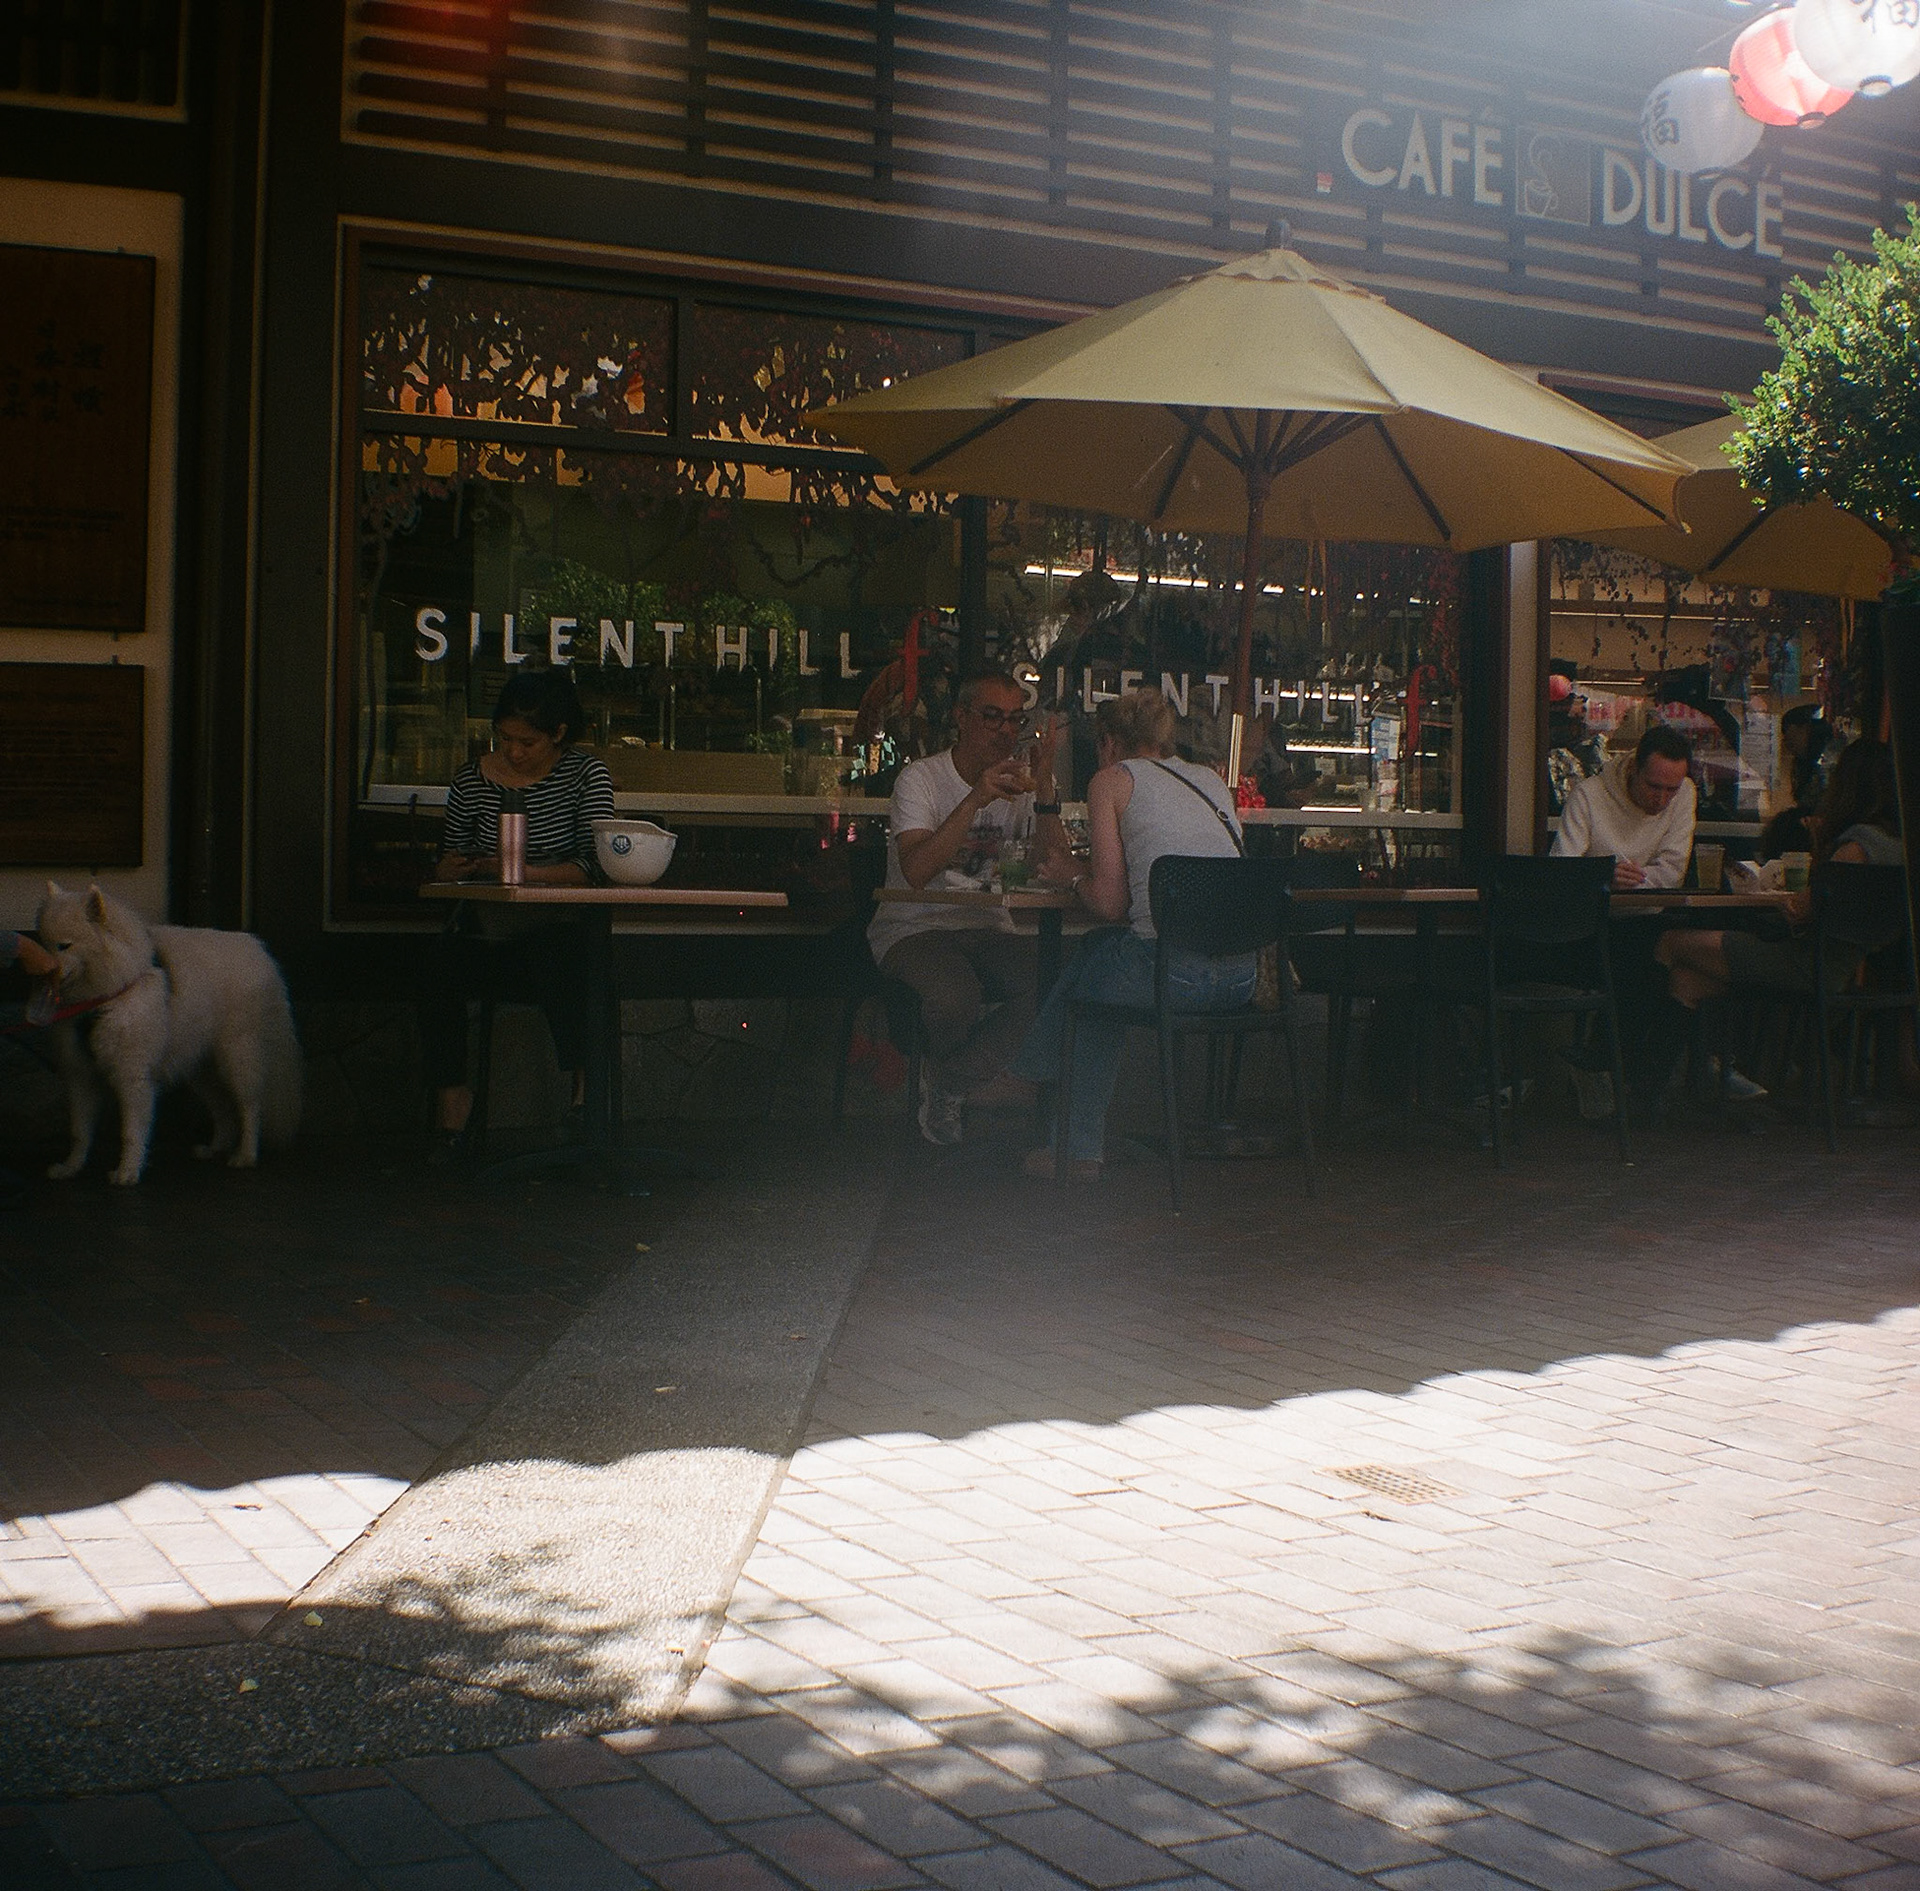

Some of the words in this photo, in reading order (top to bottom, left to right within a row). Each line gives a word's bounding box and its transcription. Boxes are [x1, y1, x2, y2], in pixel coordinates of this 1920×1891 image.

[1342, 106, 1503, 206] CAFÉ
[1603, 149, 1784, 258] DULCÉ
[415, 605, 685, 669] SILENT
[715, 623, 862, 679] HILL
[1012, 661, 1229, 718] SILENT
[1254, 676, 1373, 726] HILL
